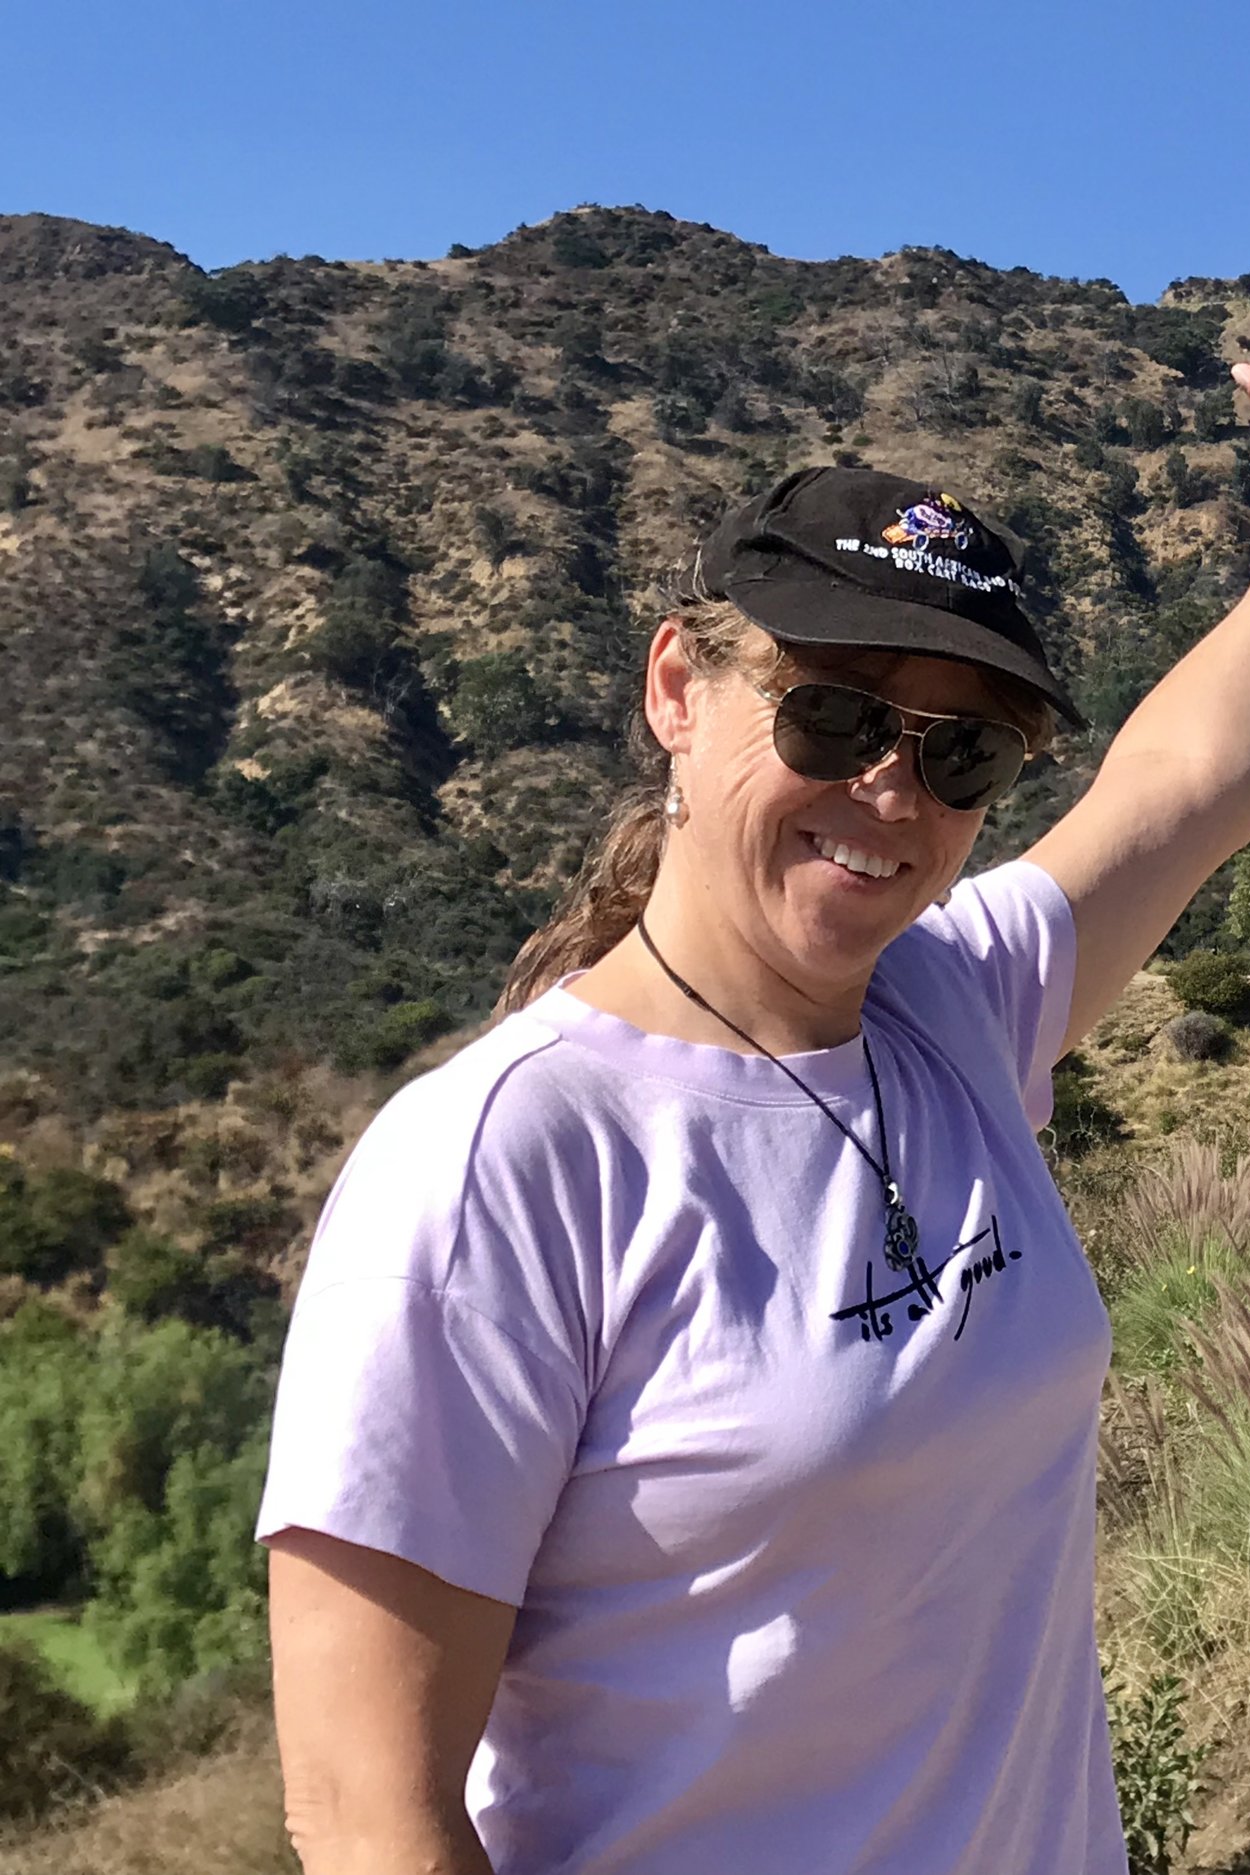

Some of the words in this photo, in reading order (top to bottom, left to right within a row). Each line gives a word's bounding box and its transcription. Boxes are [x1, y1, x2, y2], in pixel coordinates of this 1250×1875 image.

[835, 538, 860, 551] THE
[891, 547, 933, 563] SOUTH
[895, 557, 925, 573] BOX
[927, 563, 957, 581] CART
